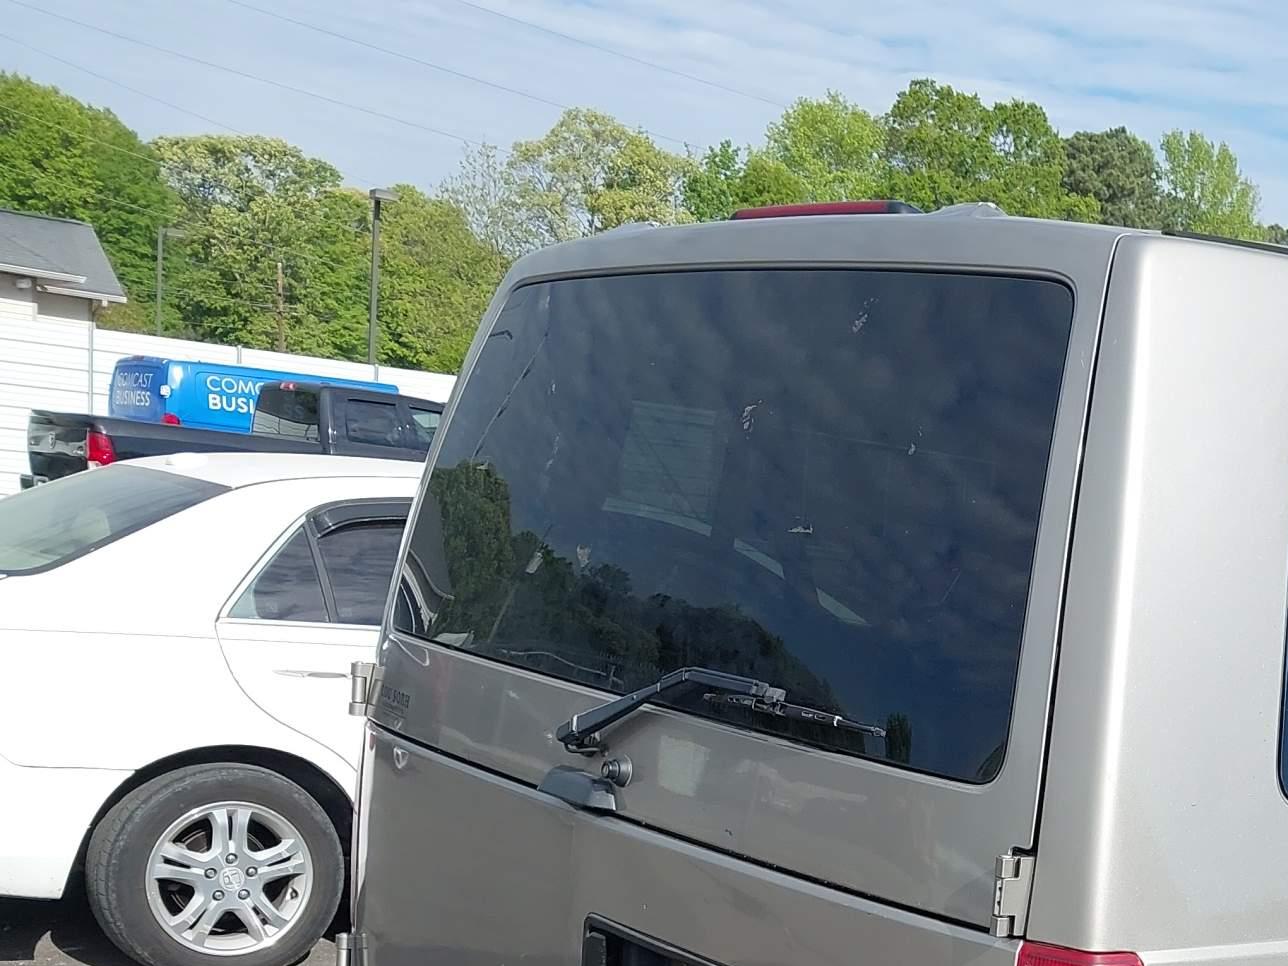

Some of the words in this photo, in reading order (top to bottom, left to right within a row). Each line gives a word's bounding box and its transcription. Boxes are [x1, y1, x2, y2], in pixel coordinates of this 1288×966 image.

[117, 373, 153, 388] COMCAST
[115, 389, 151, 406] BUSINESS
[208, 393, 254, 414] BUSI
